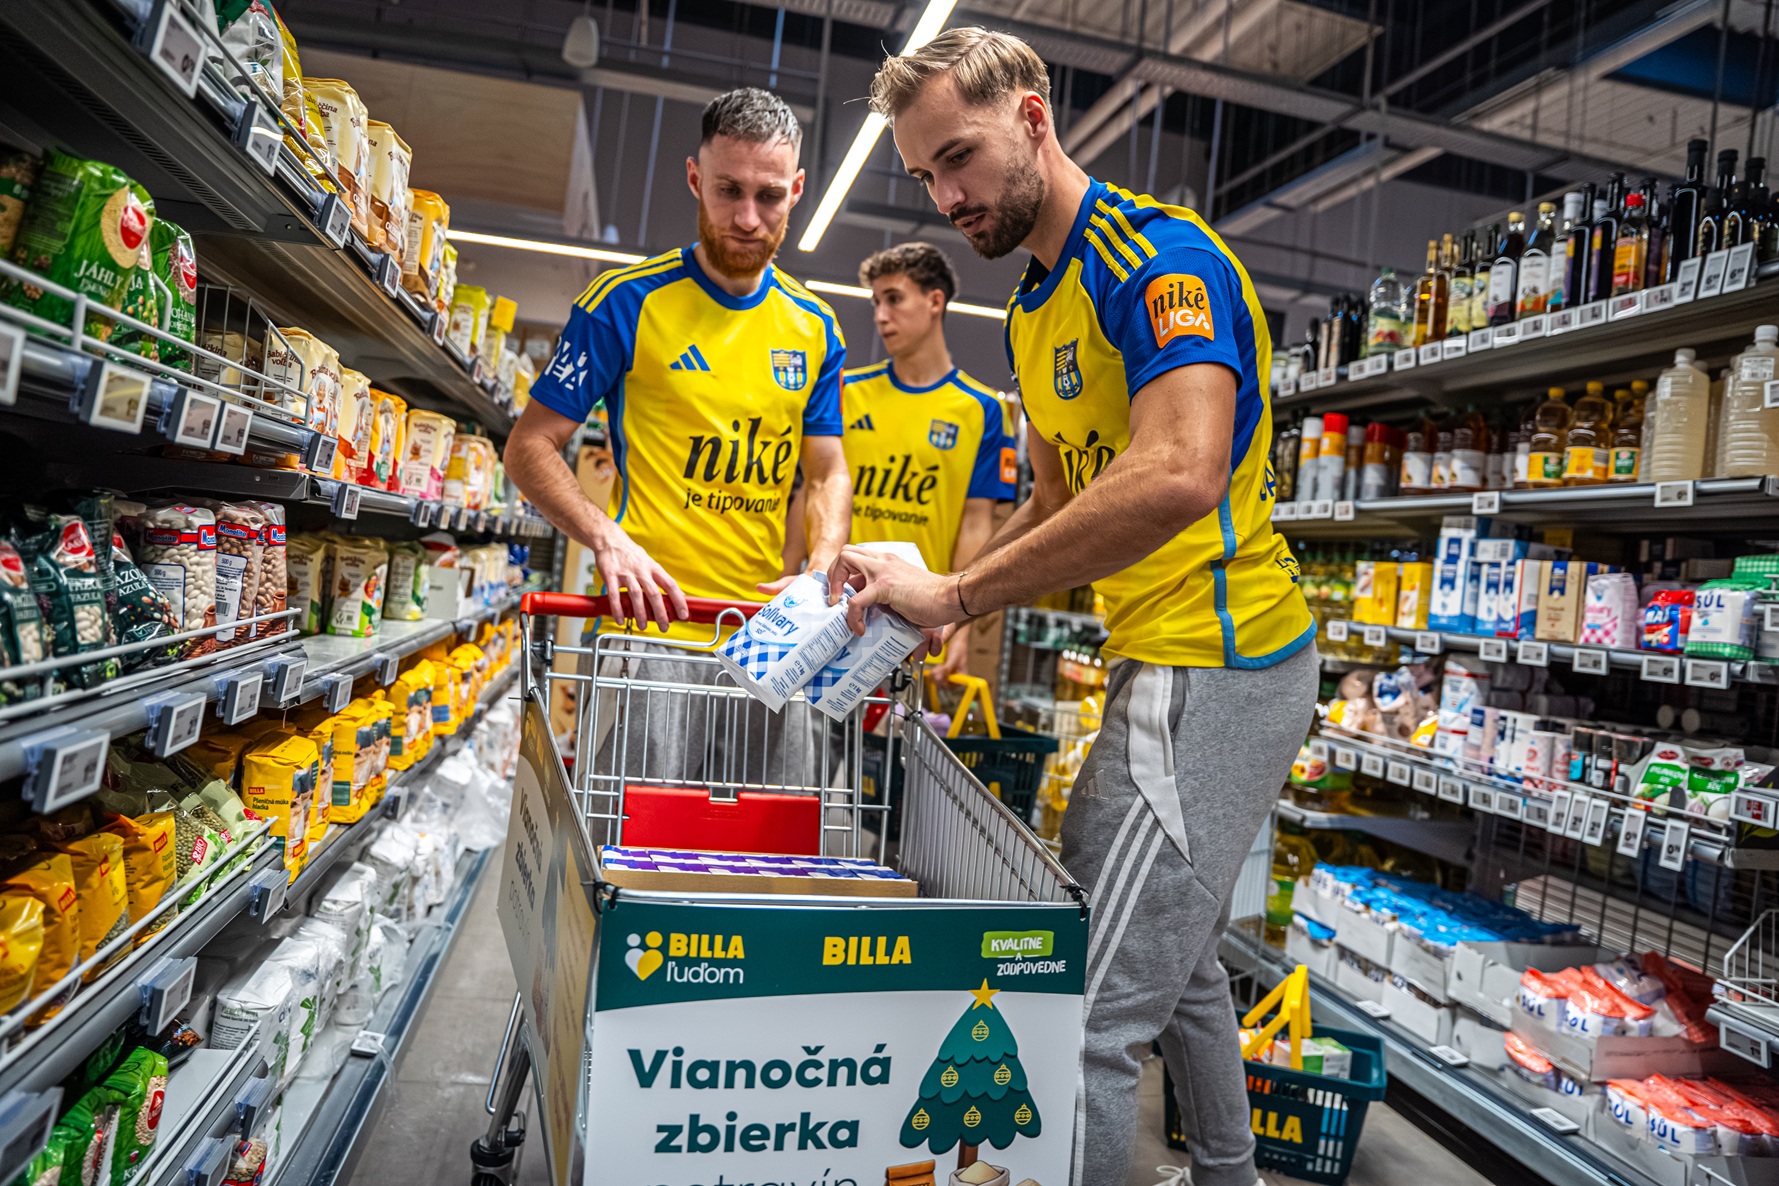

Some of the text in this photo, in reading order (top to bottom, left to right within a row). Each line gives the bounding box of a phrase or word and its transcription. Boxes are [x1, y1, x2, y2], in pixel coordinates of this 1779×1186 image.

[1152, 281, 1205, 319] niké
[1158, 309, 1210, 338] LIGA
[683, 416, 792, 485] niké
[854, 453, 939, 505] niké
[684, 488, 702, 509] je
[758, 604, 799, 637] Solivary
[669, 932, 745, 959] BILLA
[822, 936, 912, 966] BILLA
[991, 937, 1043, 952] KVALITNE
[1015, 952, 1022, 961] A
[666, 961, 744, 984] ľuďom
[996, 960, 1067, 976] ZODPOVEDNE
[627, 1043, 893, 1091] Vianočná
[654, 1111, 861, 1154] zbierka
[1252, 1107, 1303, 1144] LLA
